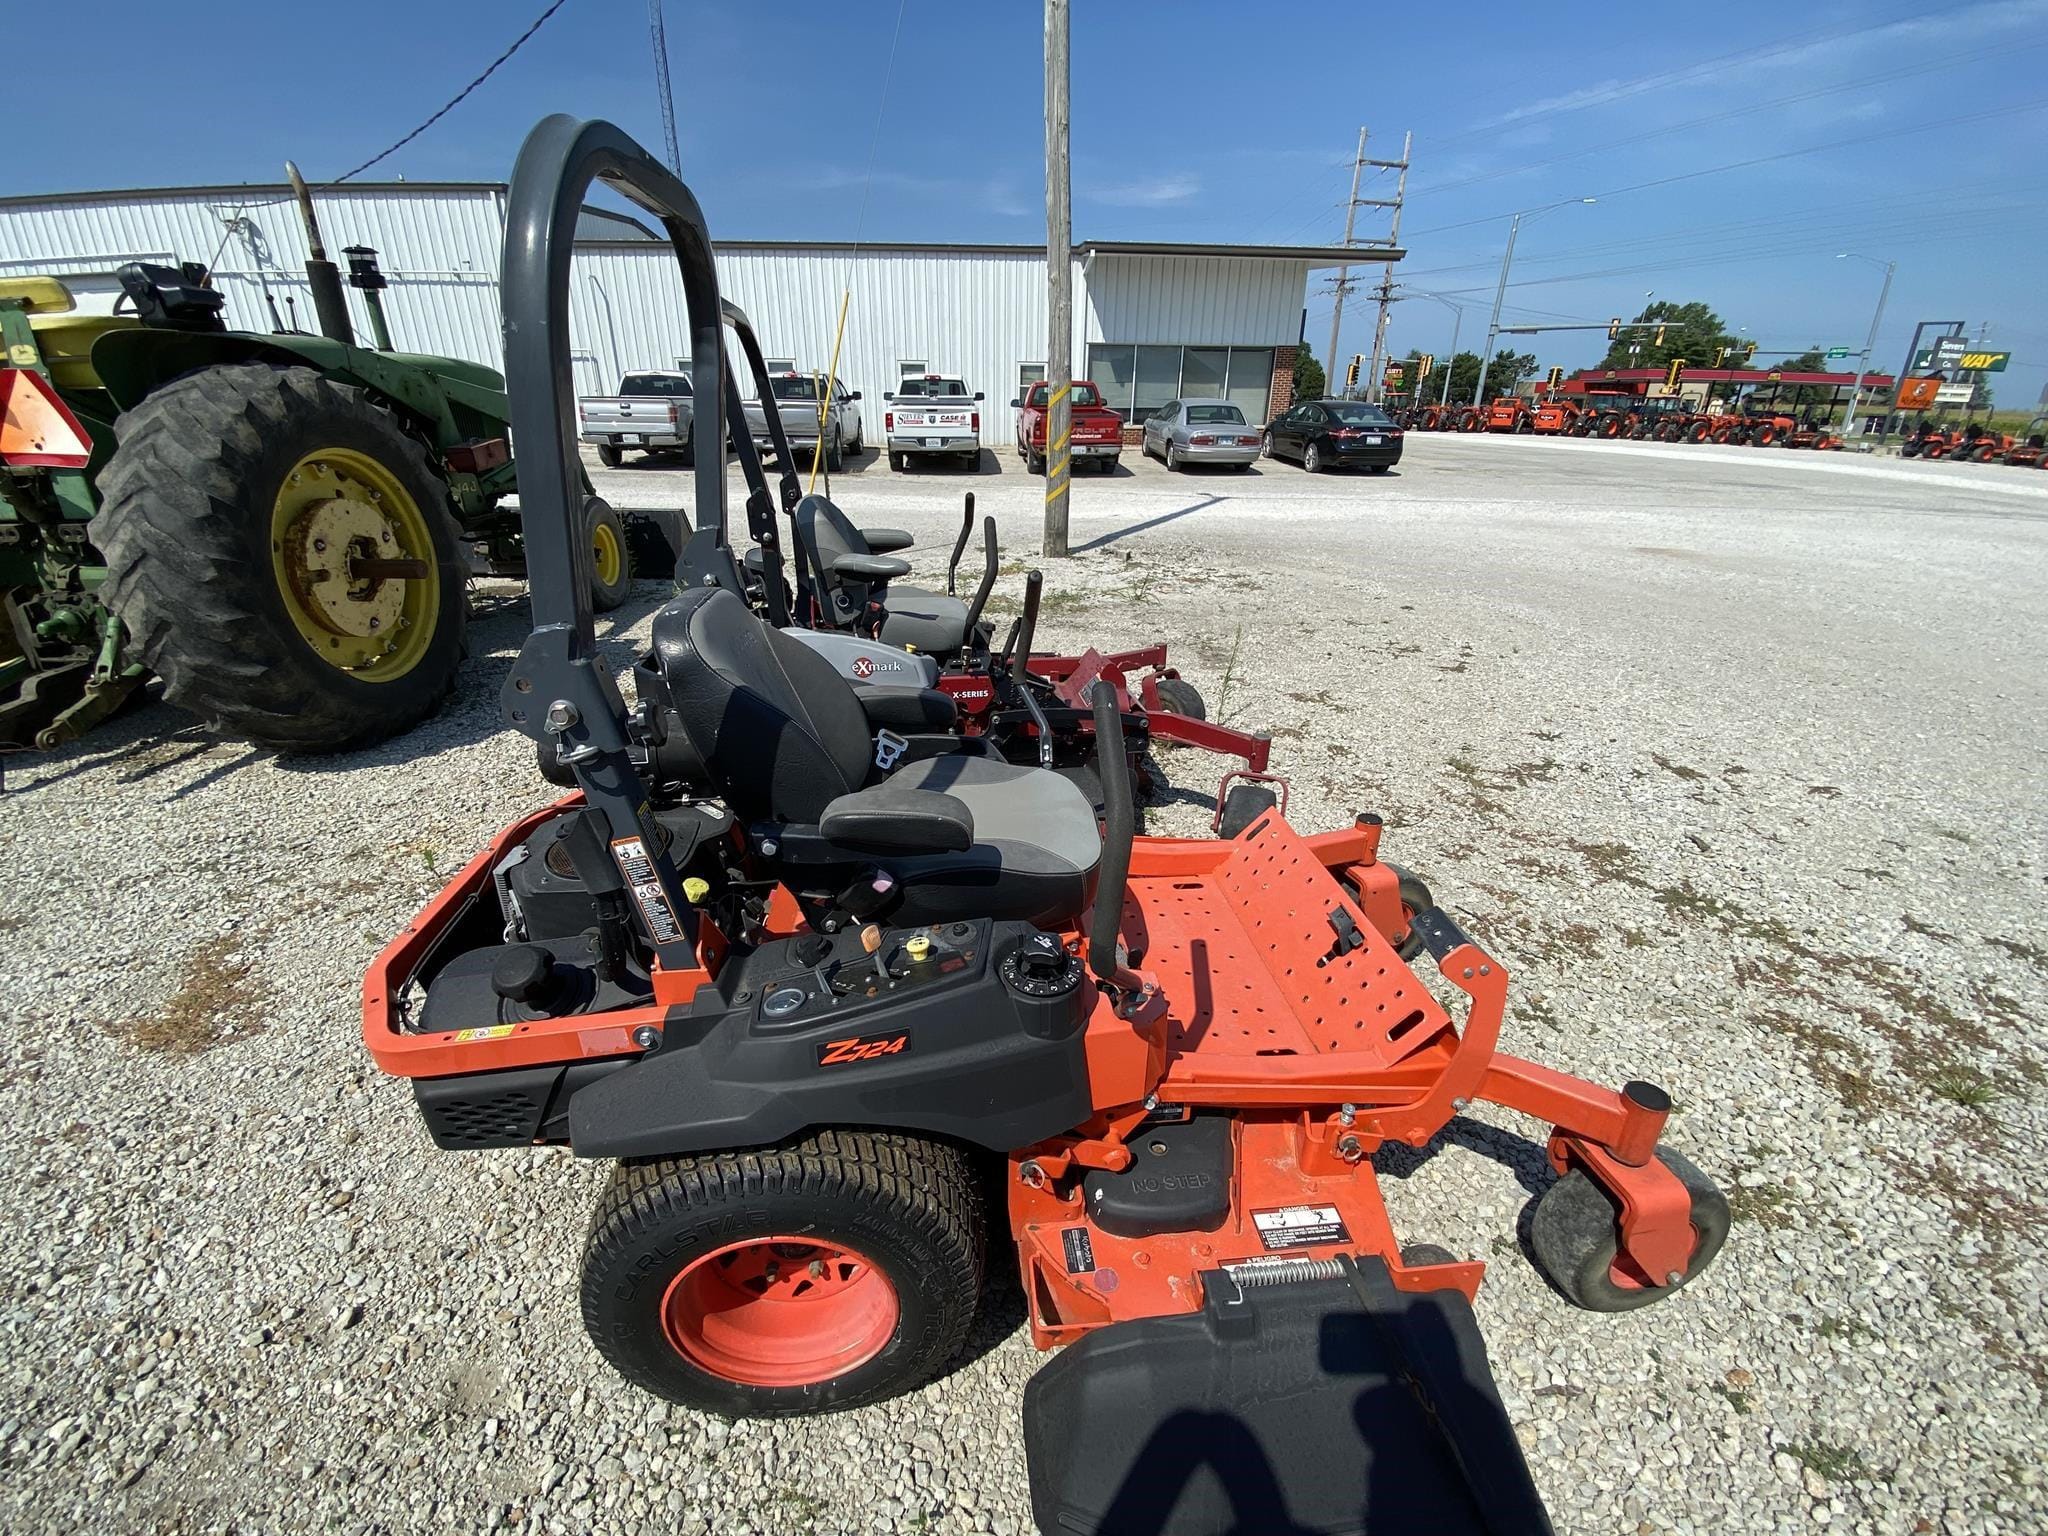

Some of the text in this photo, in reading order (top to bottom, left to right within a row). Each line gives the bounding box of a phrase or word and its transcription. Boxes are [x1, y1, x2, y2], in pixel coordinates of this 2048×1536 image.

[1941, 340, 1965, 351] Sievers
[952, 689, 989, 699] X-SERIES
[820, 1036, 907, 1065] Z724
[1131, 1173, 1210, 1194] NO STEP
[1251, 1255, 1281, 1263] PELIGRO
